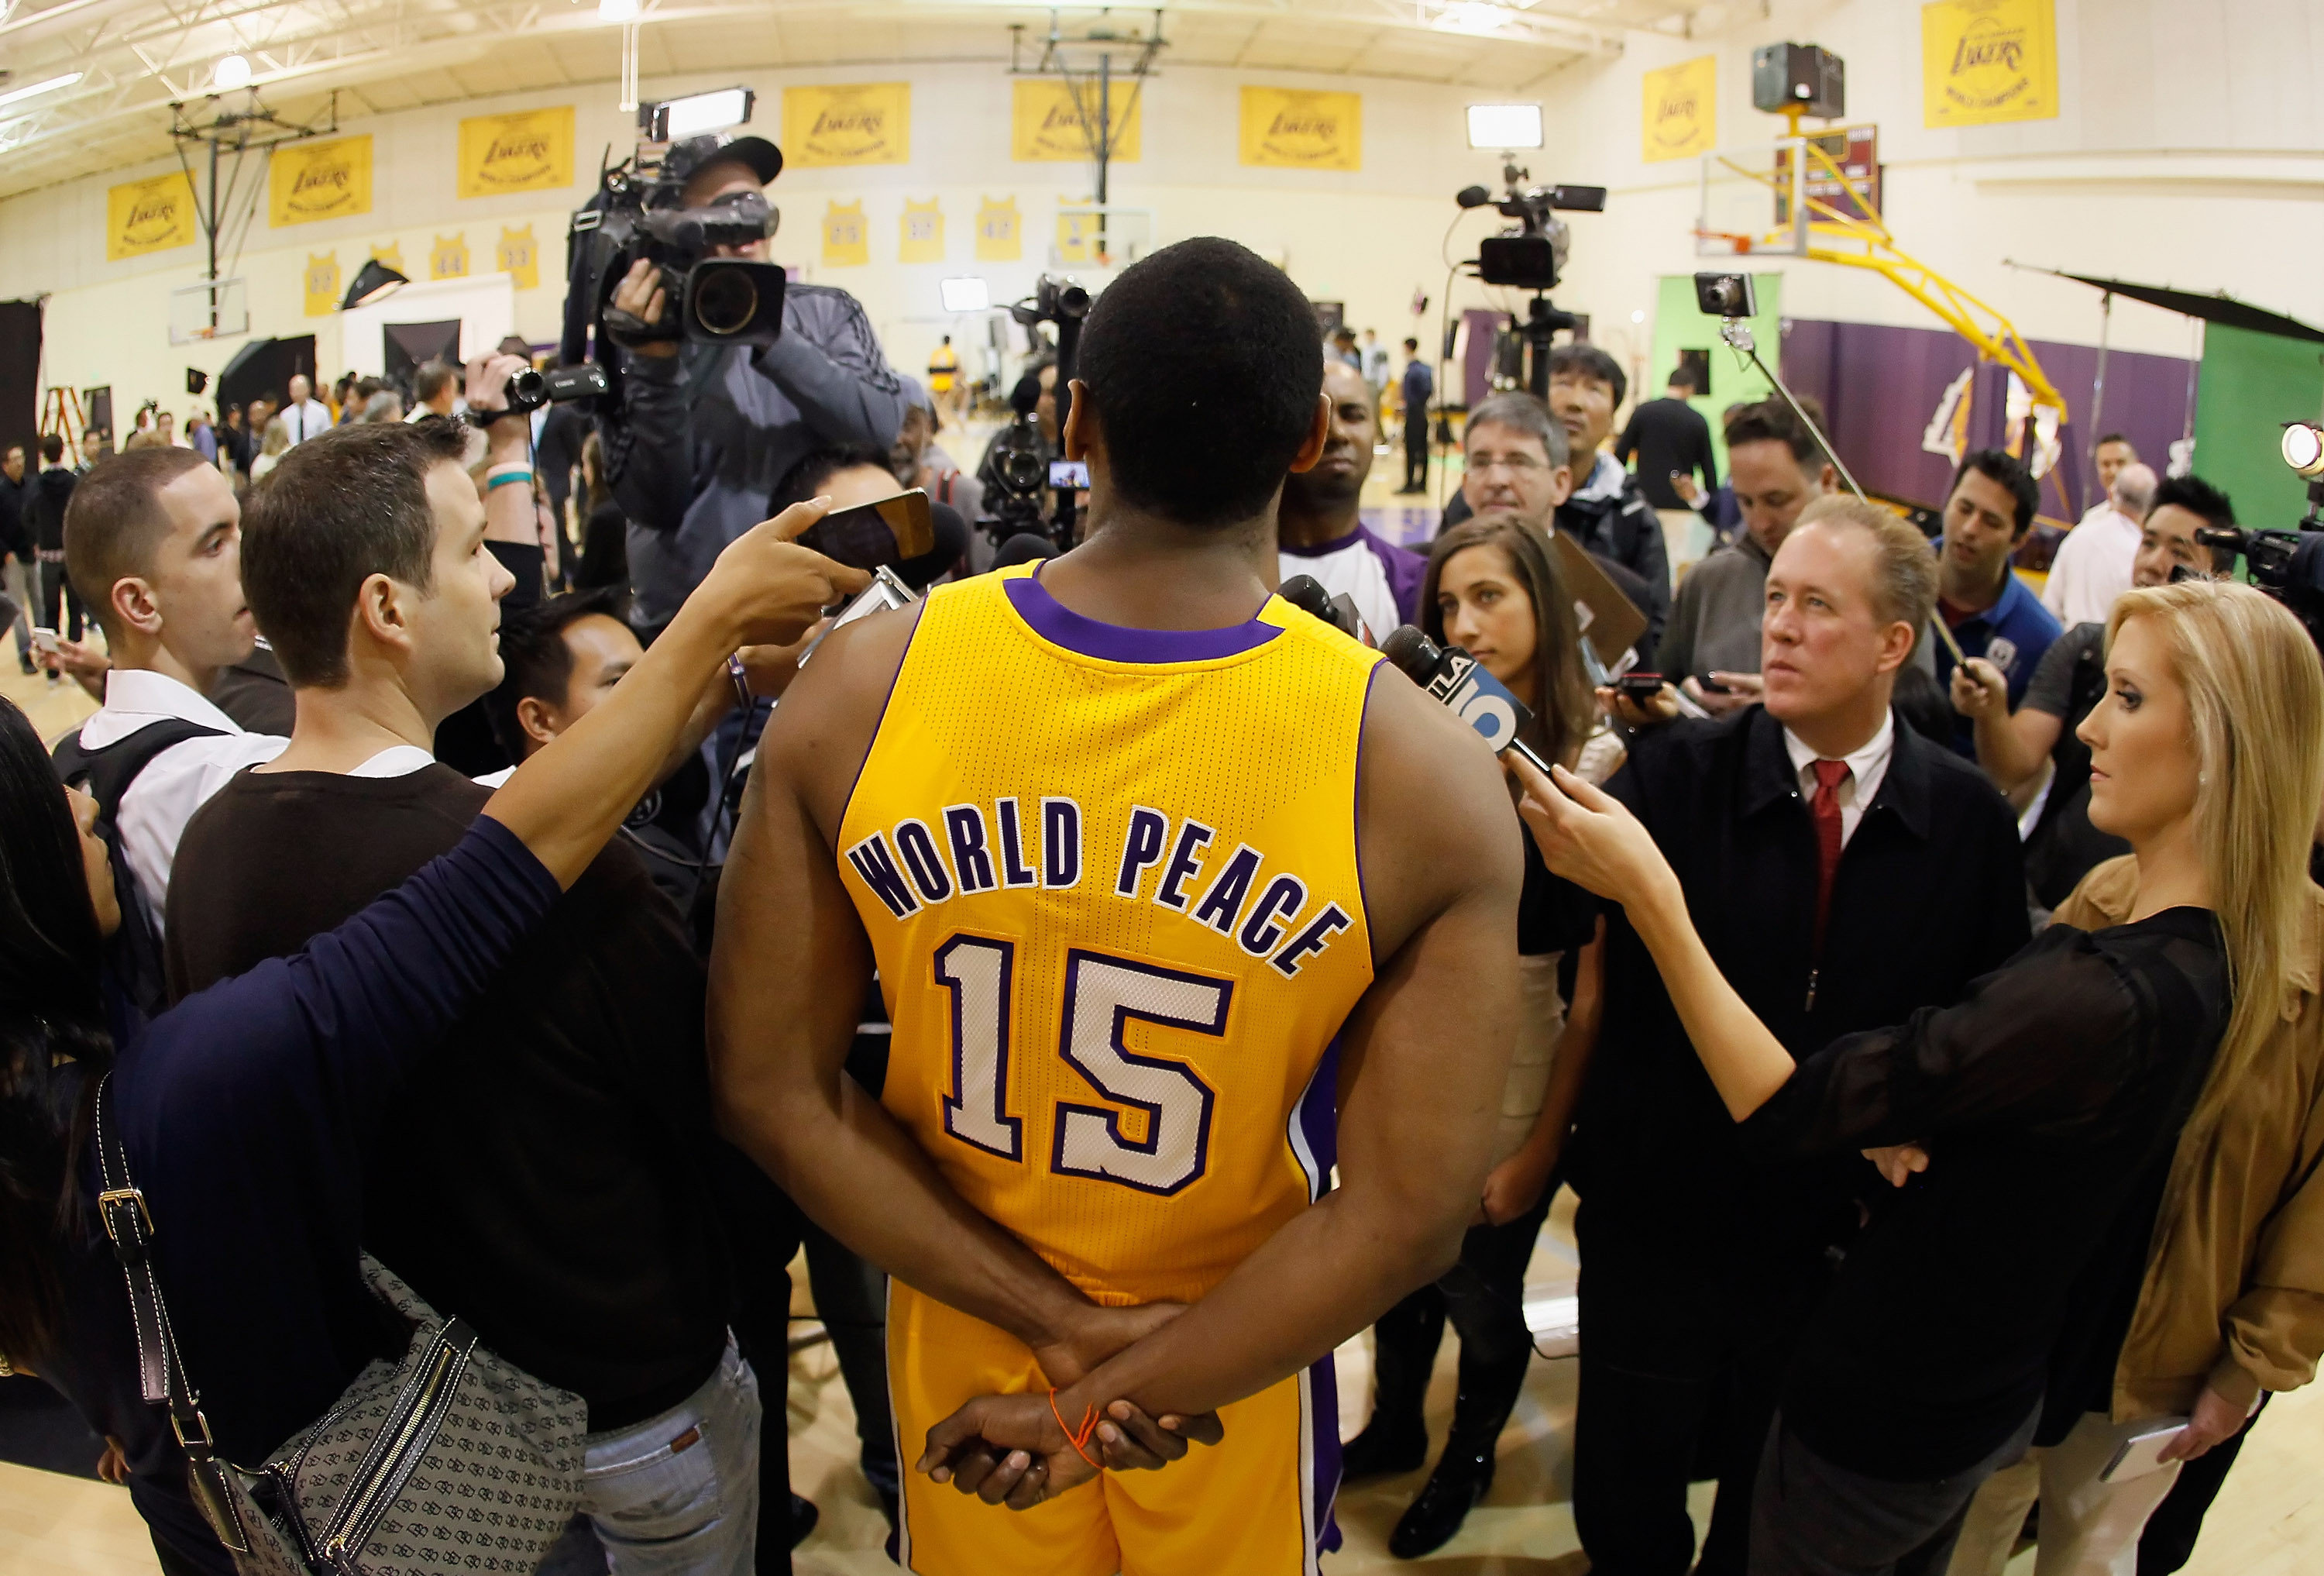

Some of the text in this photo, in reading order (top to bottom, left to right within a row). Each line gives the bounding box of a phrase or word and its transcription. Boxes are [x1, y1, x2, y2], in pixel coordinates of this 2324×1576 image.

[1426, 656, 1473, 697] TLA
[845, 797, 1355, 980] WORLD PEACE
[933, 933, 1235, 1196] 15
